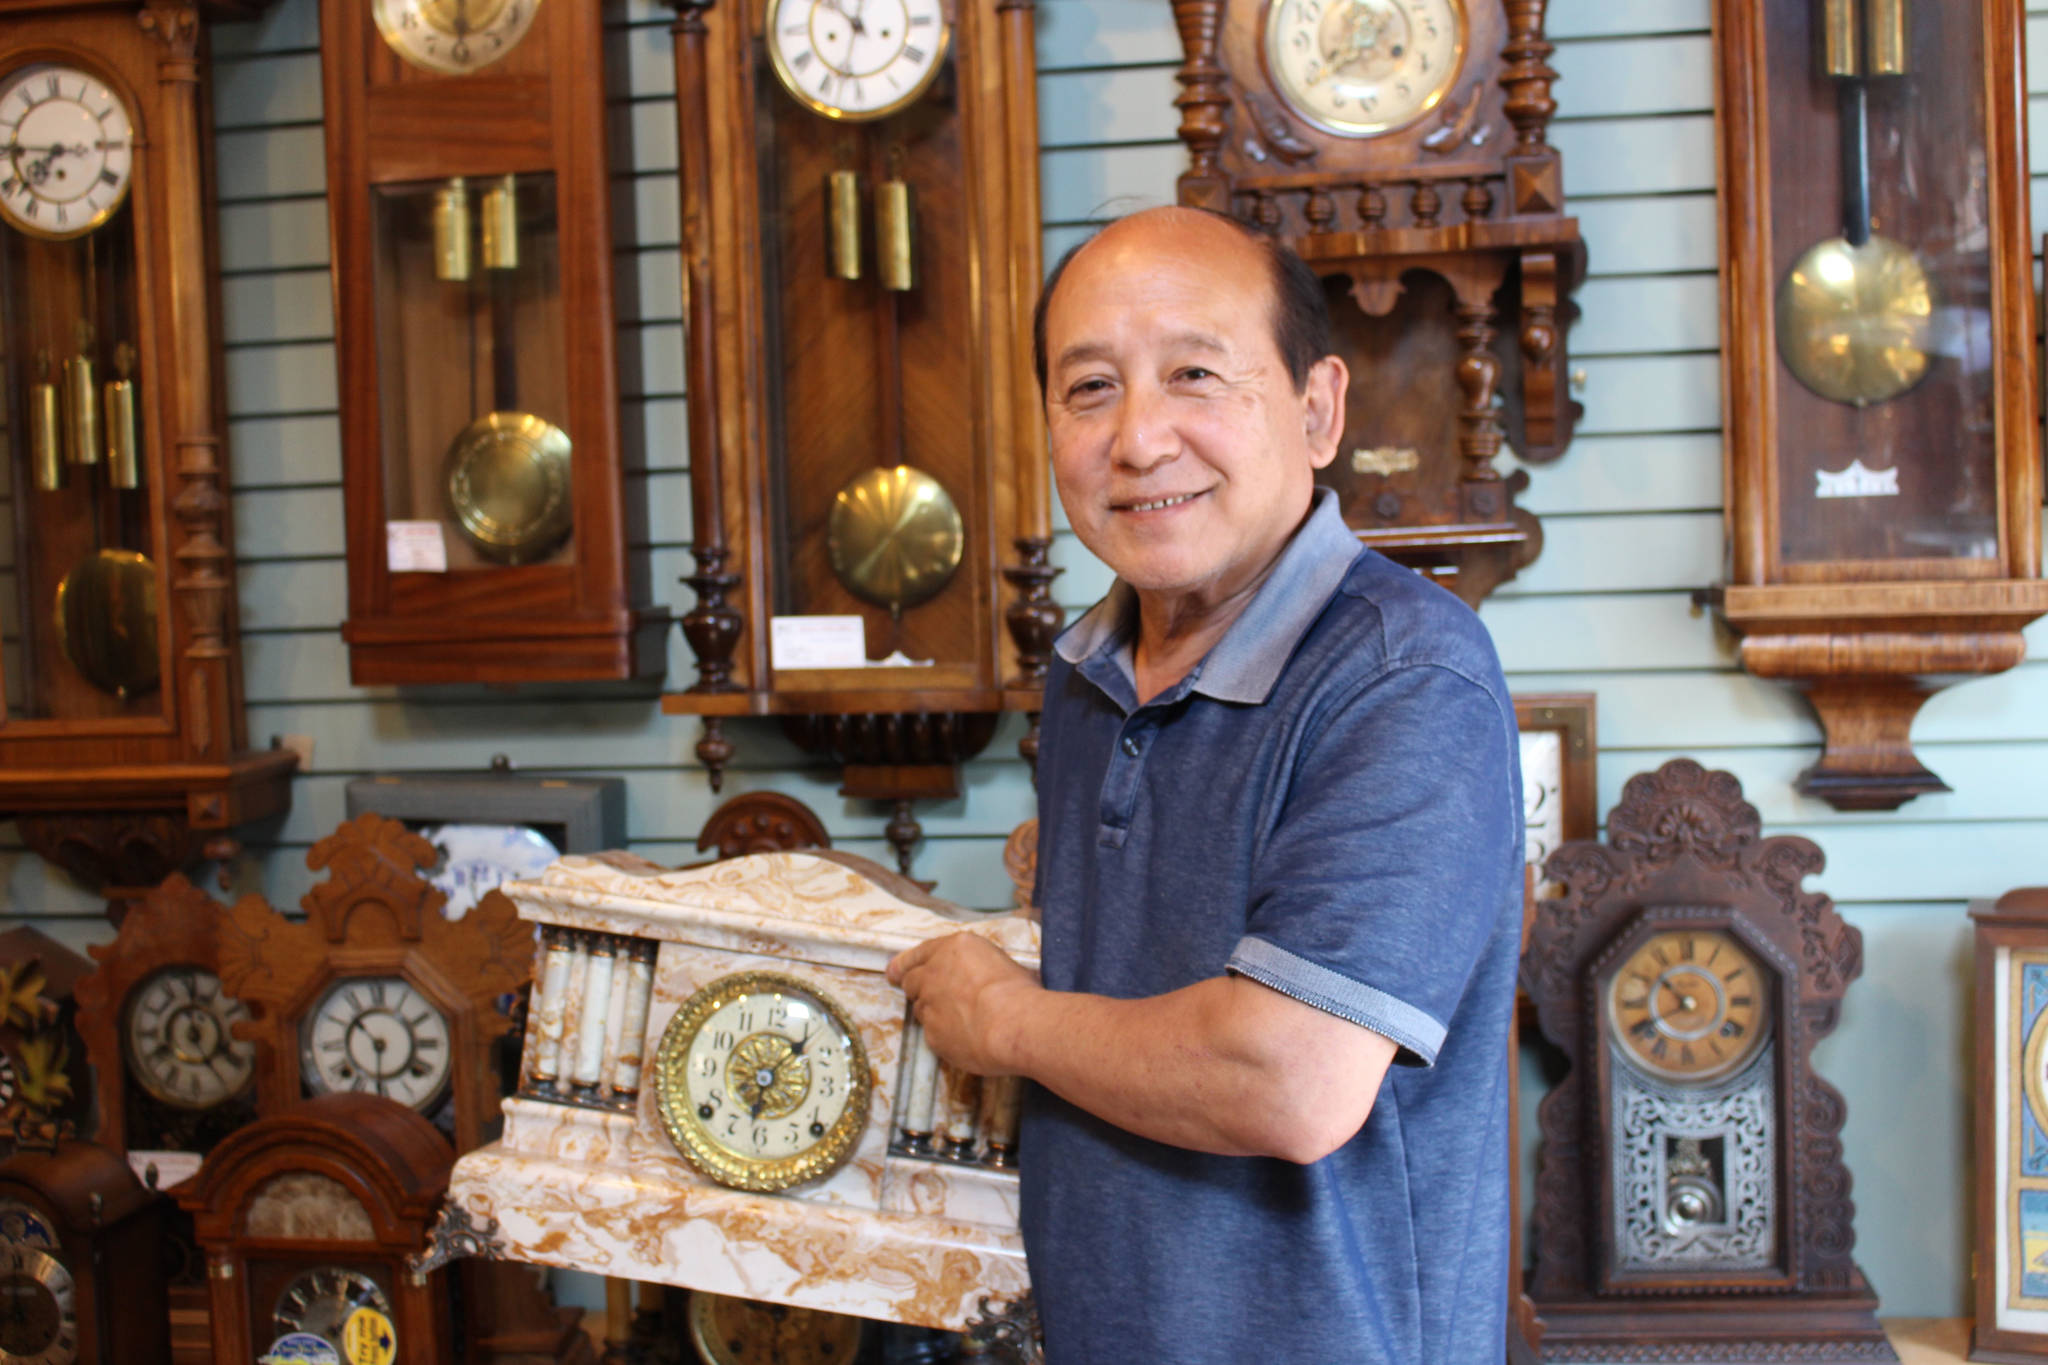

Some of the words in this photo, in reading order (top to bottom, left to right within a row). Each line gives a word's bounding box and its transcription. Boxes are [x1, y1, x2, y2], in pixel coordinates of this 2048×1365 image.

[738, 1012, 753, 1032] 11
[768, 1007, 788, 1028] 12
[713, 1031, 734, 1050] 10
[702, 1058, 716, 1077] 9
[818, 1047, 832, 1068] 2
[819, 1076, 834, 1097] 3
[709, 1089, 723, 1108] 8
[727, 1113, 740, 1135] 7
[784, 1122, 799, 1144] 5
[752, 1126, 768, 1147] 6
